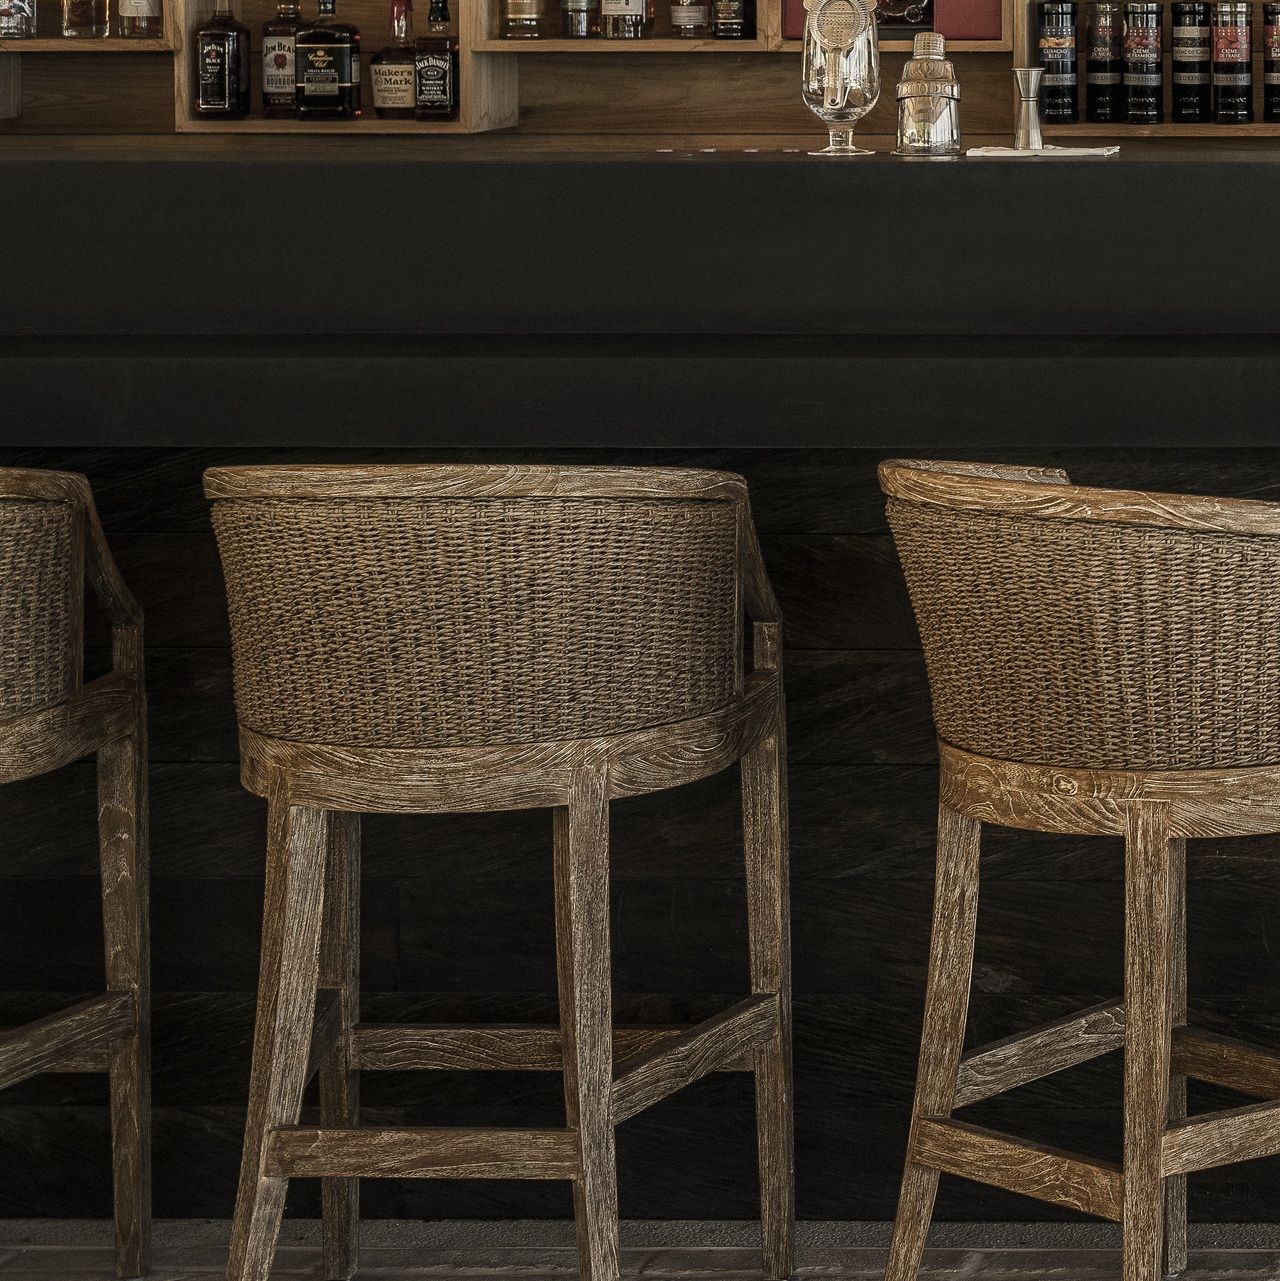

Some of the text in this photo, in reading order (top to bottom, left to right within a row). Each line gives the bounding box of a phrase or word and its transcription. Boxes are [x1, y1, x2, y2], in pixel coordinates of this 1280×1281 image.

[264, 44, 277, 58] JIM
[373, 68, 413, 77] Maker's
[383, 77, 413, 86] Mark
